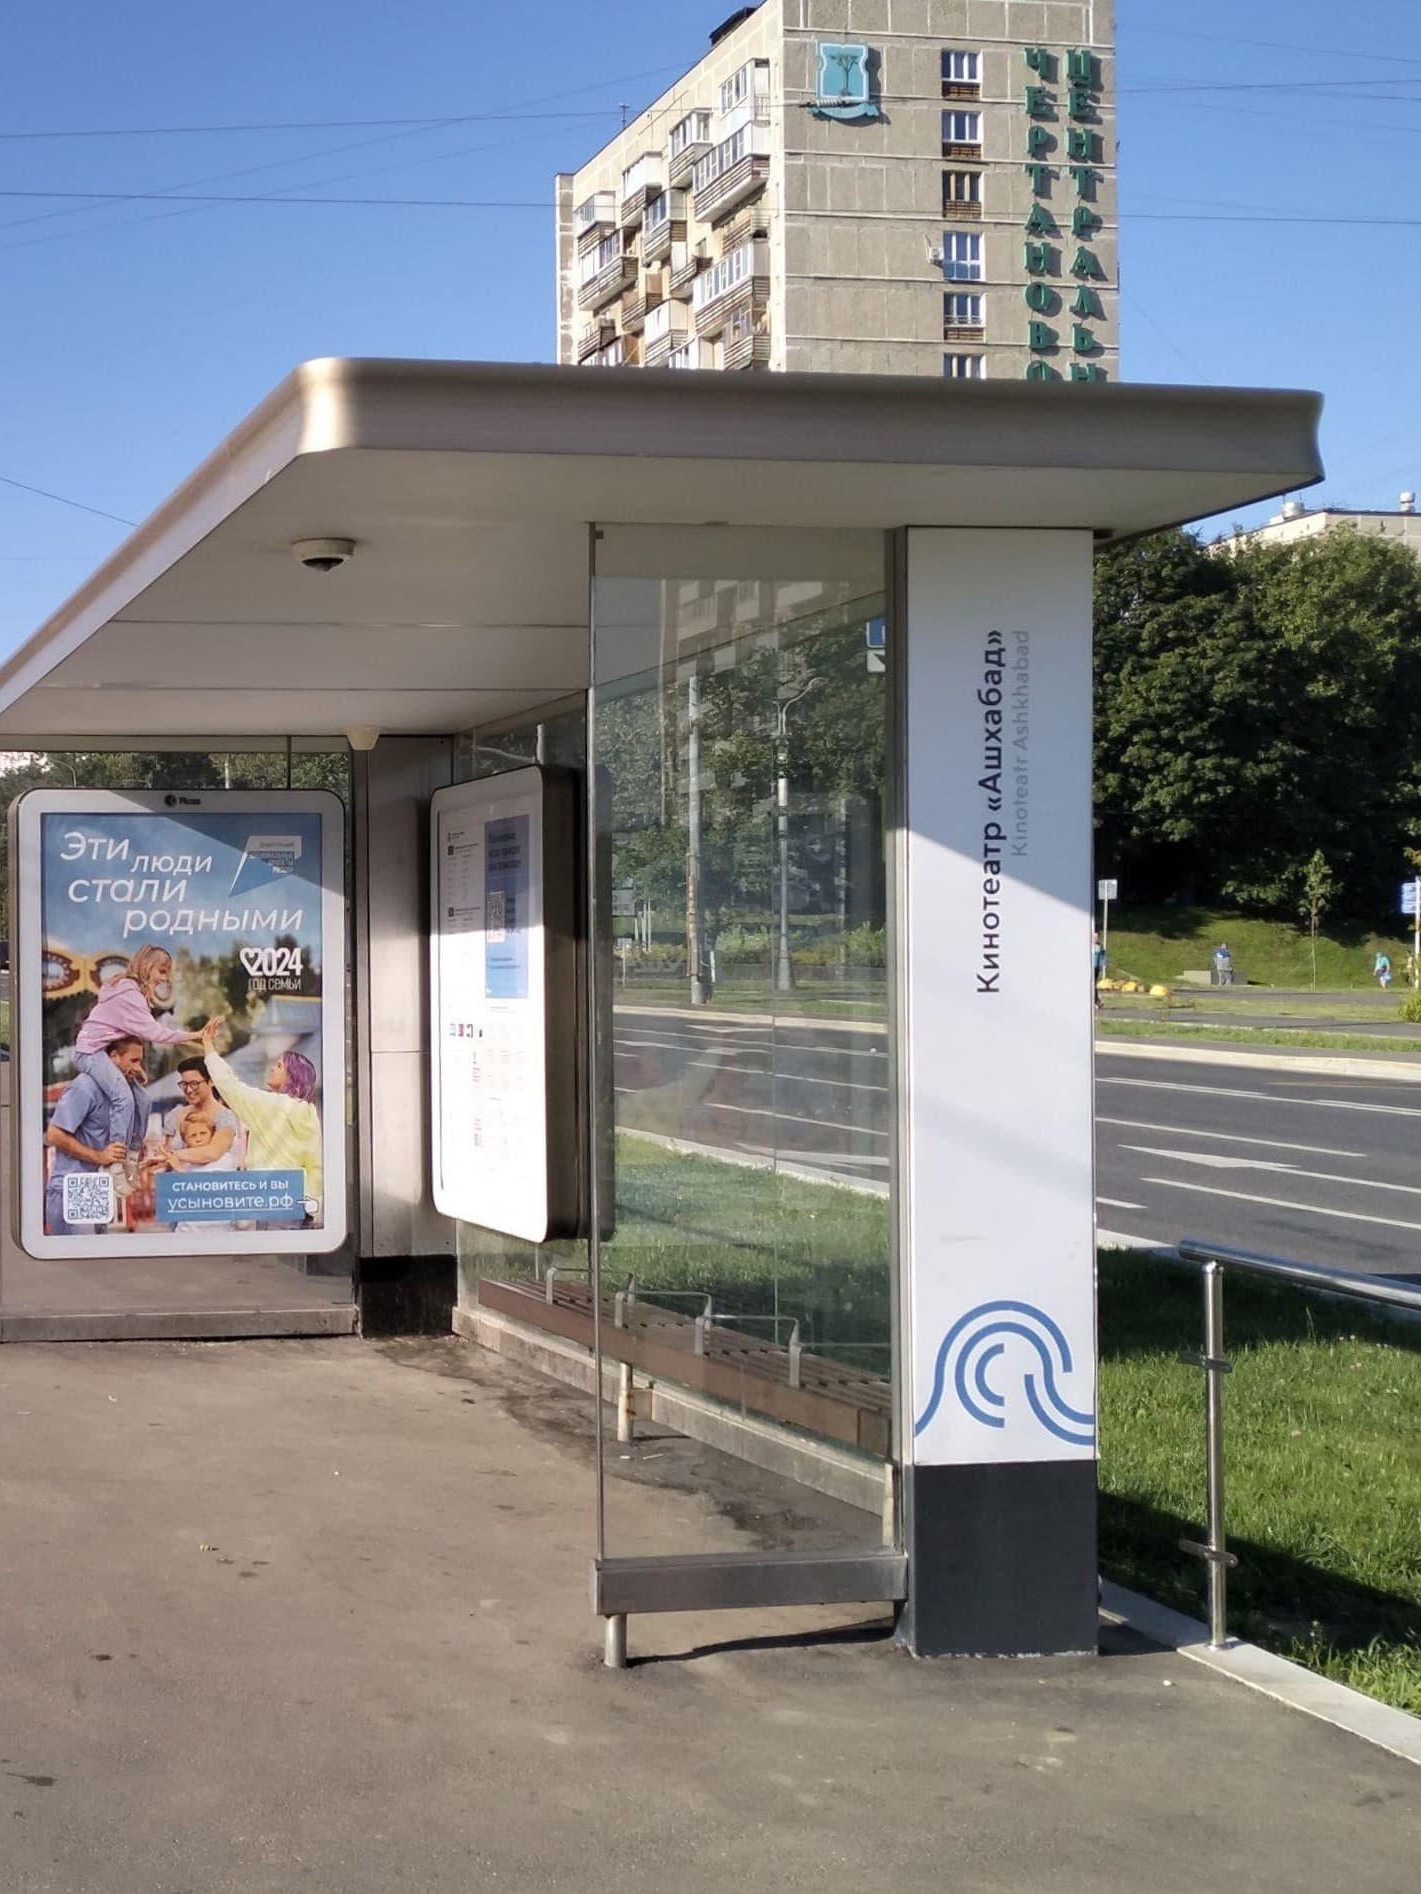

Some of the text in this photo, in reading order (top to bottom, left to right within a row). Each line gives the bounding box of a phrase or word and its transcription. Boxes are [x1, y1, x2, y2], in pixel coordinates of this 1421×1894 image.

[1012, 630, 1029, 856] Kinoteatr Ashkhabad
[977, 630, 1007, 993] Кинотеатр «Ашхабад»
[60, 831, 213, 876] Эти люди
[68, 879, 188, 903] стали
[123, 909, 304, 939] родными
[240, 947, 304, 976] 2024
[172, 1180, 289, 1192] СТАНОВИТЕСЬ И ВЫ
[168, 1192, 294, 1210] усыновите.рф
